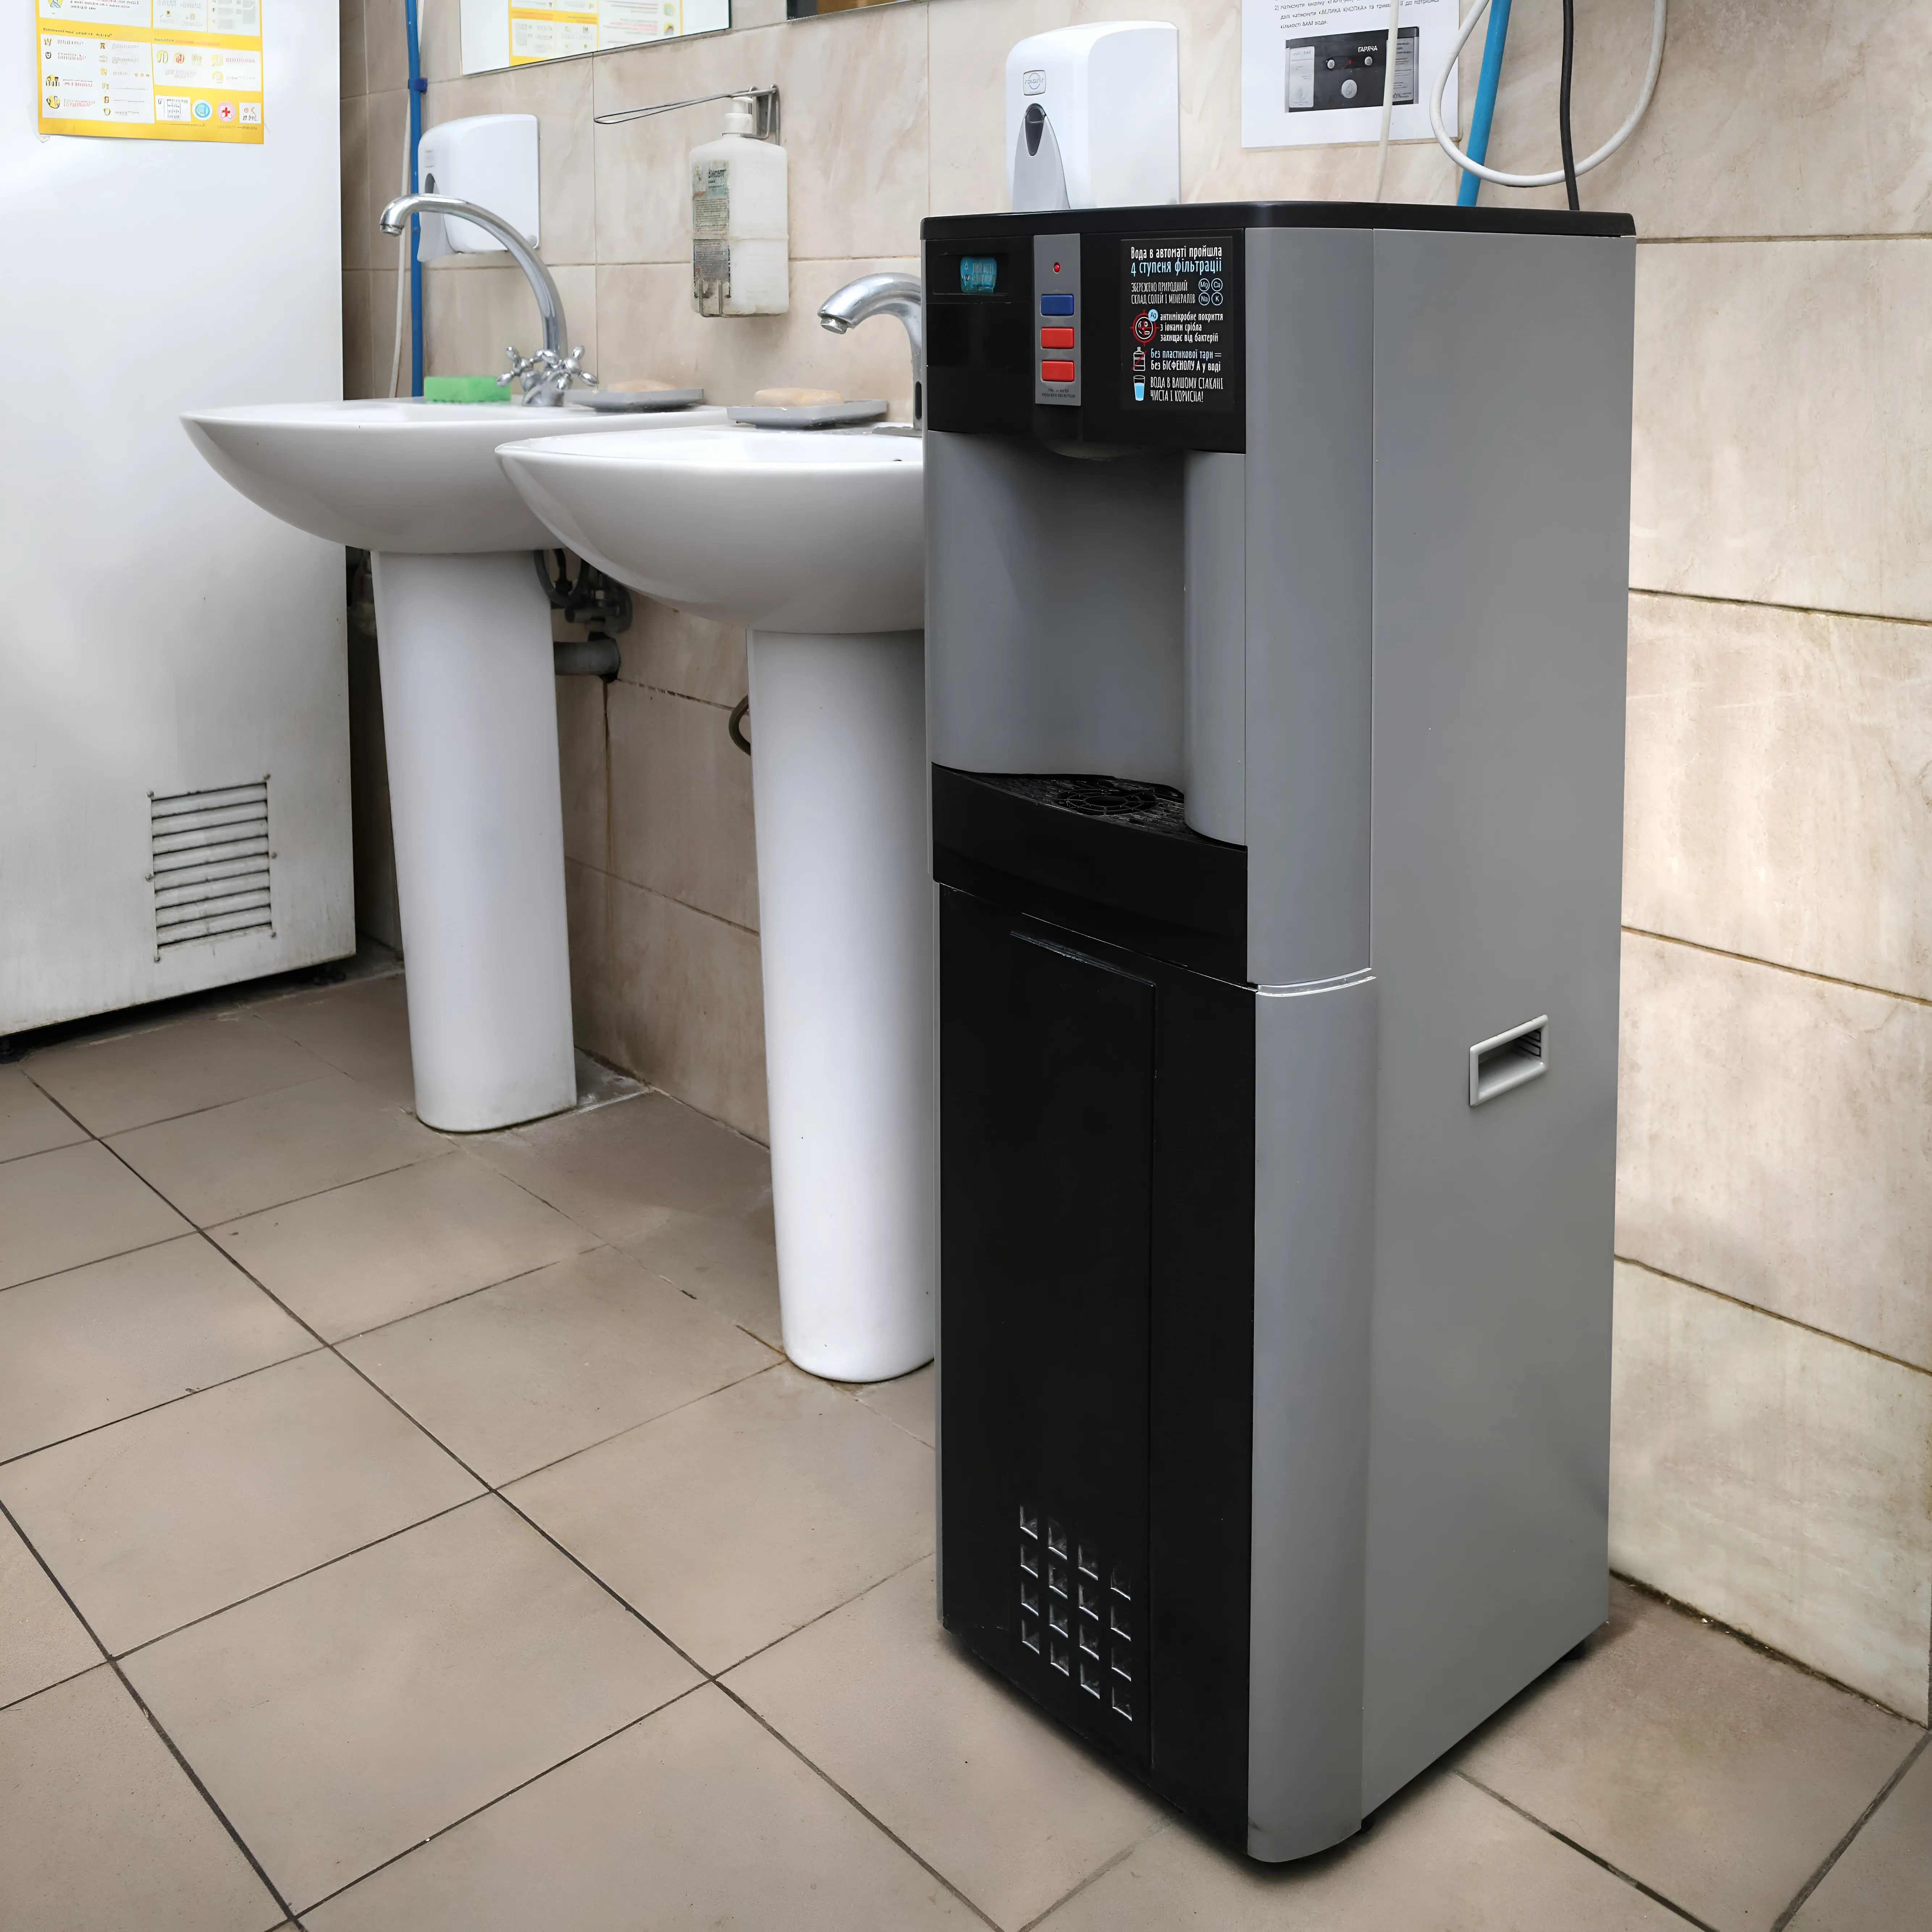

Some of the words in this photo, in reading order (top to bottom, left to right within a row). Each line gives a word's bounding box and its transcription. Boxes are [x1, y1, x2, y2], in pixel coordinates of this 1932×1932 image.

[1131, 247, 1147, 260] Вода
[1150, 249, 1153, 258] в
[1156, 246, 1186, 258] автоматі
[1189, 245, 1222, 260] пройшла
[1131, 263, 1136, 277] 4
[1139, 261, 1171, 277] ступеня
[1198, 314, 1223, 323] покриття
[1185, 322, 1202, 333] срібла
[1195, 332, 1218, 343] бактерій
[1200, 351, 1213, 361] тари
[1163, 360, 1194, 371] БІСФЕНОЛУ
[1202, 363, 1206, 373] у
[1208, 362, 1220, 373] воді
[1151, 377, 1165, 389] ВОДА
[1167, 378, 1170, 388] В
[1172, 377, 1196, 388] ВАШОМУ
[1198, 377, 1223, 389] СТАКАНІ
[1151, 390, 1168, 401] ЧИСТА
